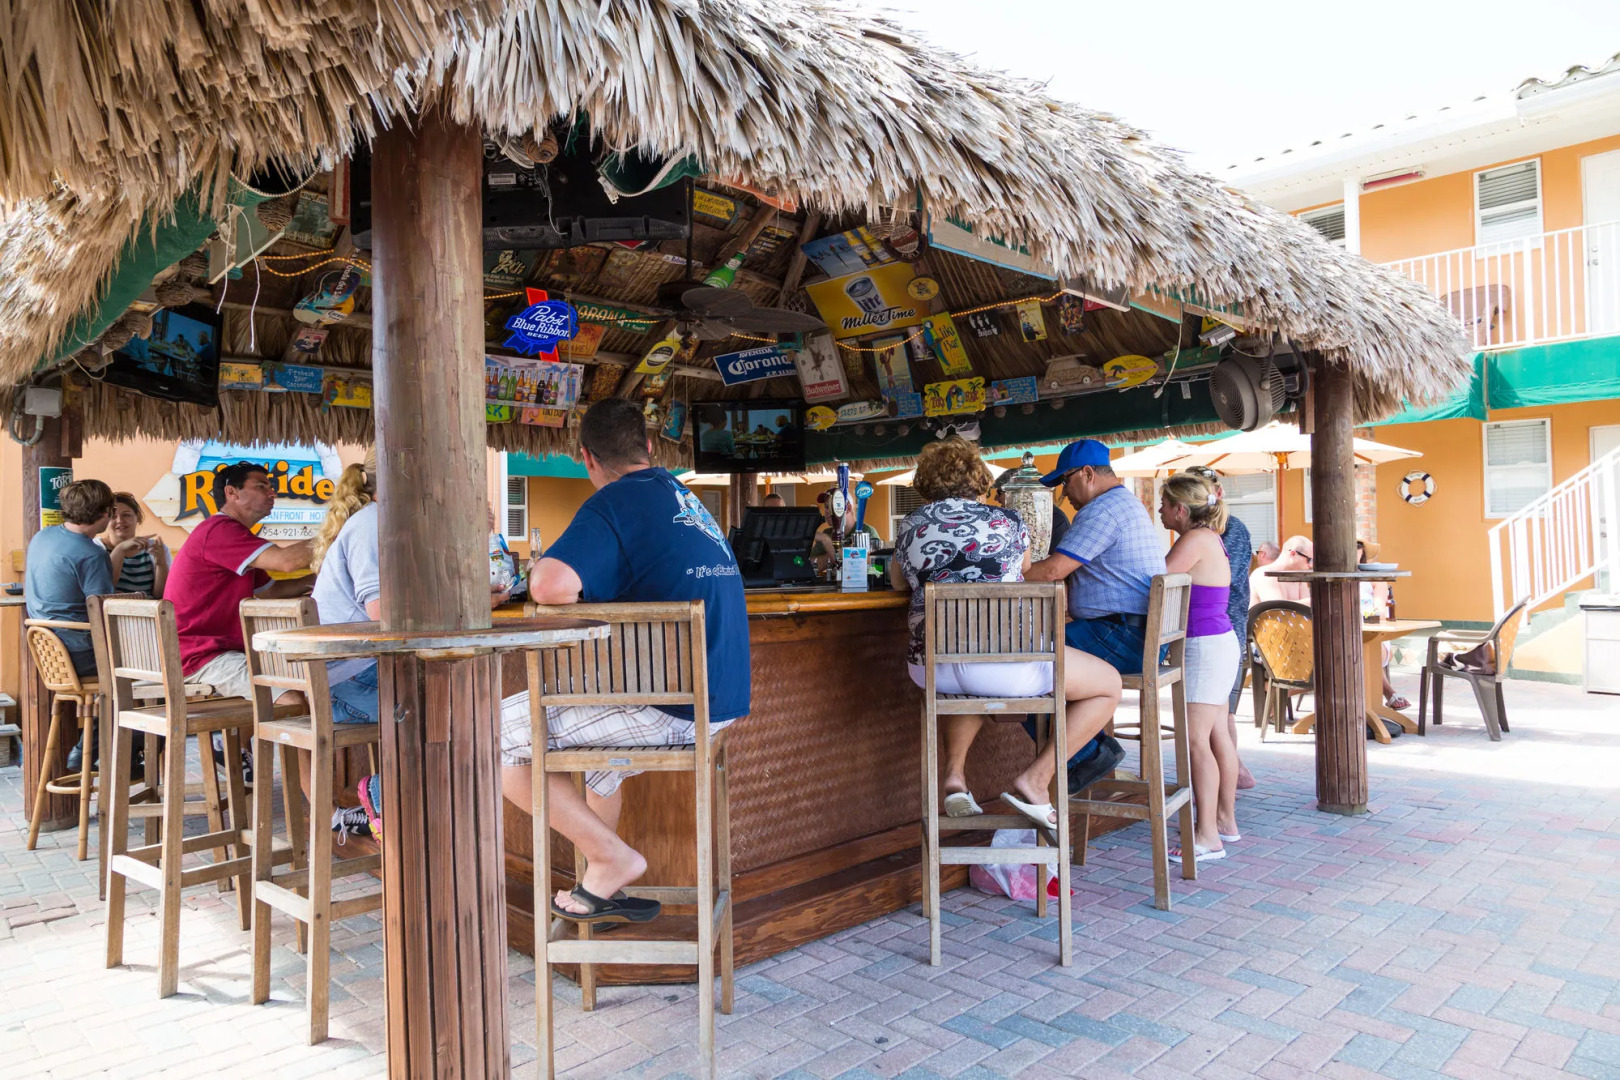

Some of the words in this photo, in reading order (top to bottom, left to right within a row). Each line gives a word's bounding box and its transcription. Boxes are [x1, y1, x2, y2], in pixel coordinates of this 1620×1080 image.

[529, 305, 570, 326] Pabst
[841, 312, 885, 330] Miller
[881, 305, 916, 321] Time
[512, 317, 535, 332] Blue
[535, 322, 570, 338] Ribbon
[526, 332, 550, 340] BEER
[739, 348, 773, 359] AVENIDA
[805, 383, 840, 395] Budweiser
